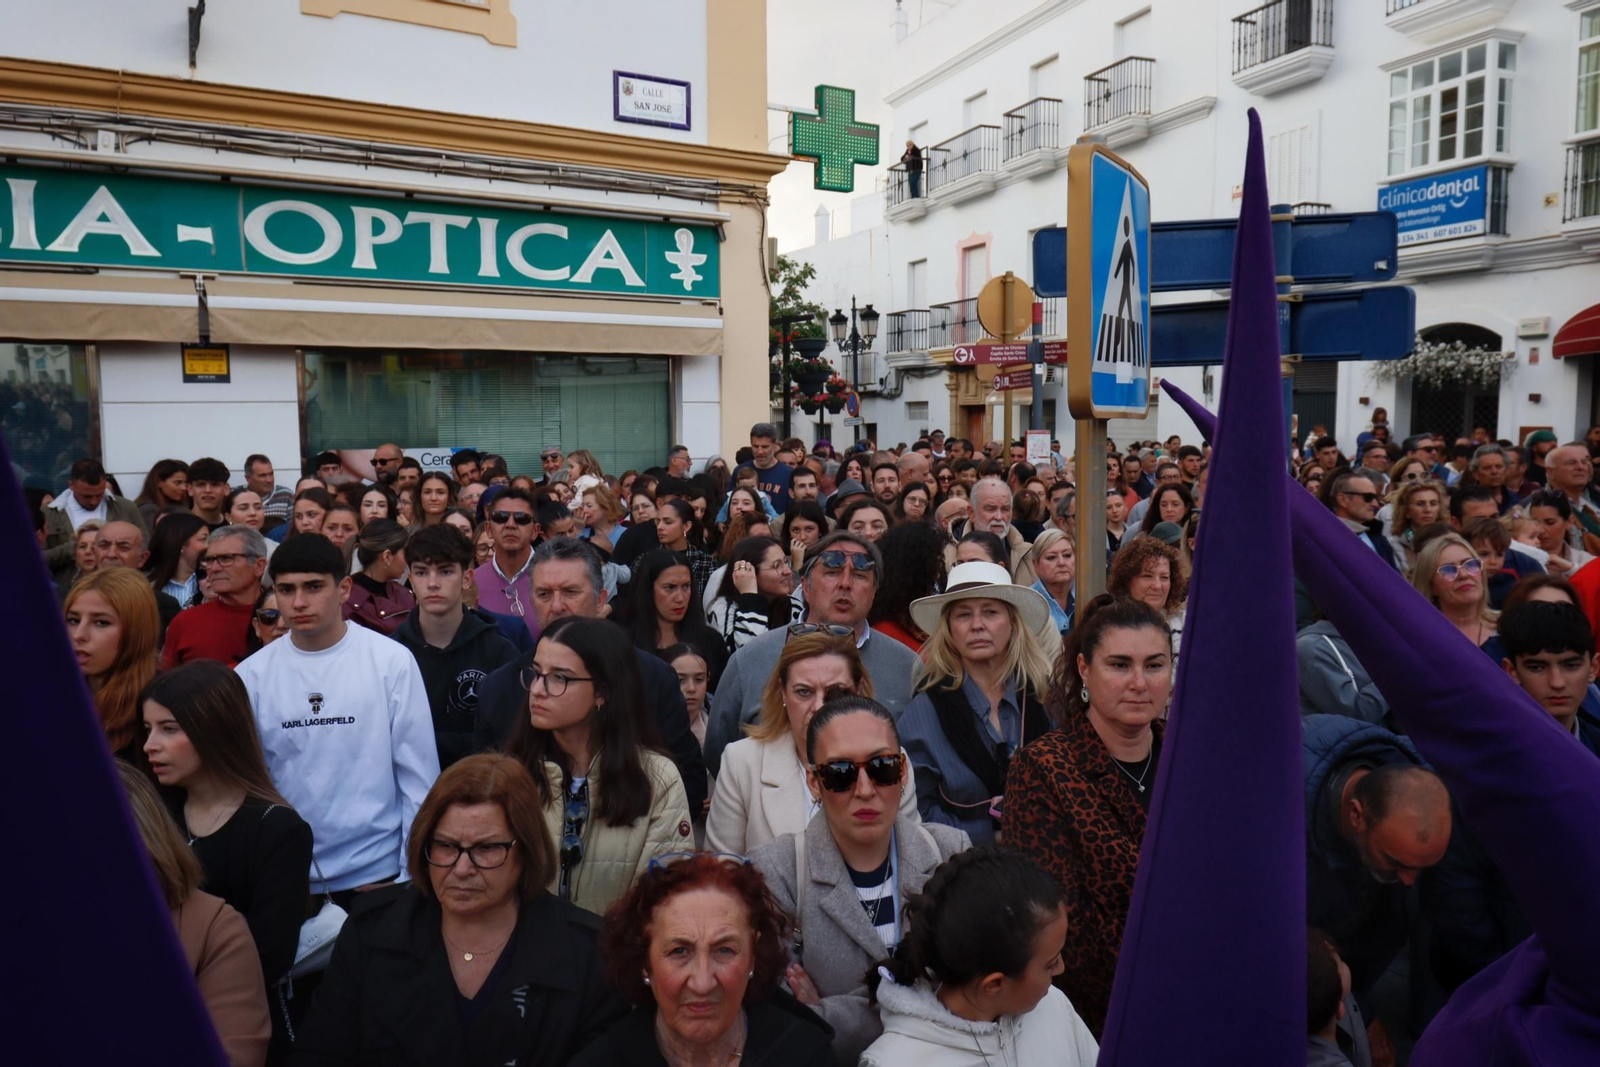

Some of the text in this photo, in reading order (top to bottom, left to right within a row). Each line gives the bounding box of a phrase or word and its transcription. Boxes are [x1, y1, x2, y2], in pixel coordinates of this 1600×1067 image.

[642, 87, 664, 98] CALLE
[634, 101, 672, 114] SAN JOSÉ
[0, 178, 162, 257] IA
[244, 200, 647, 287] OPTICA
[1416, 231, 1429, 241] 341
[1433, 228, 1447, 238] 607
[1449, 226, 1462, 236] 601
[1464, 223, 1477, 233] 824
[420, 452, 452, 467] Cera
[456, 671, 486, 684] PARIS
[281, 716, 356, 730] KARL LAGERFELD
